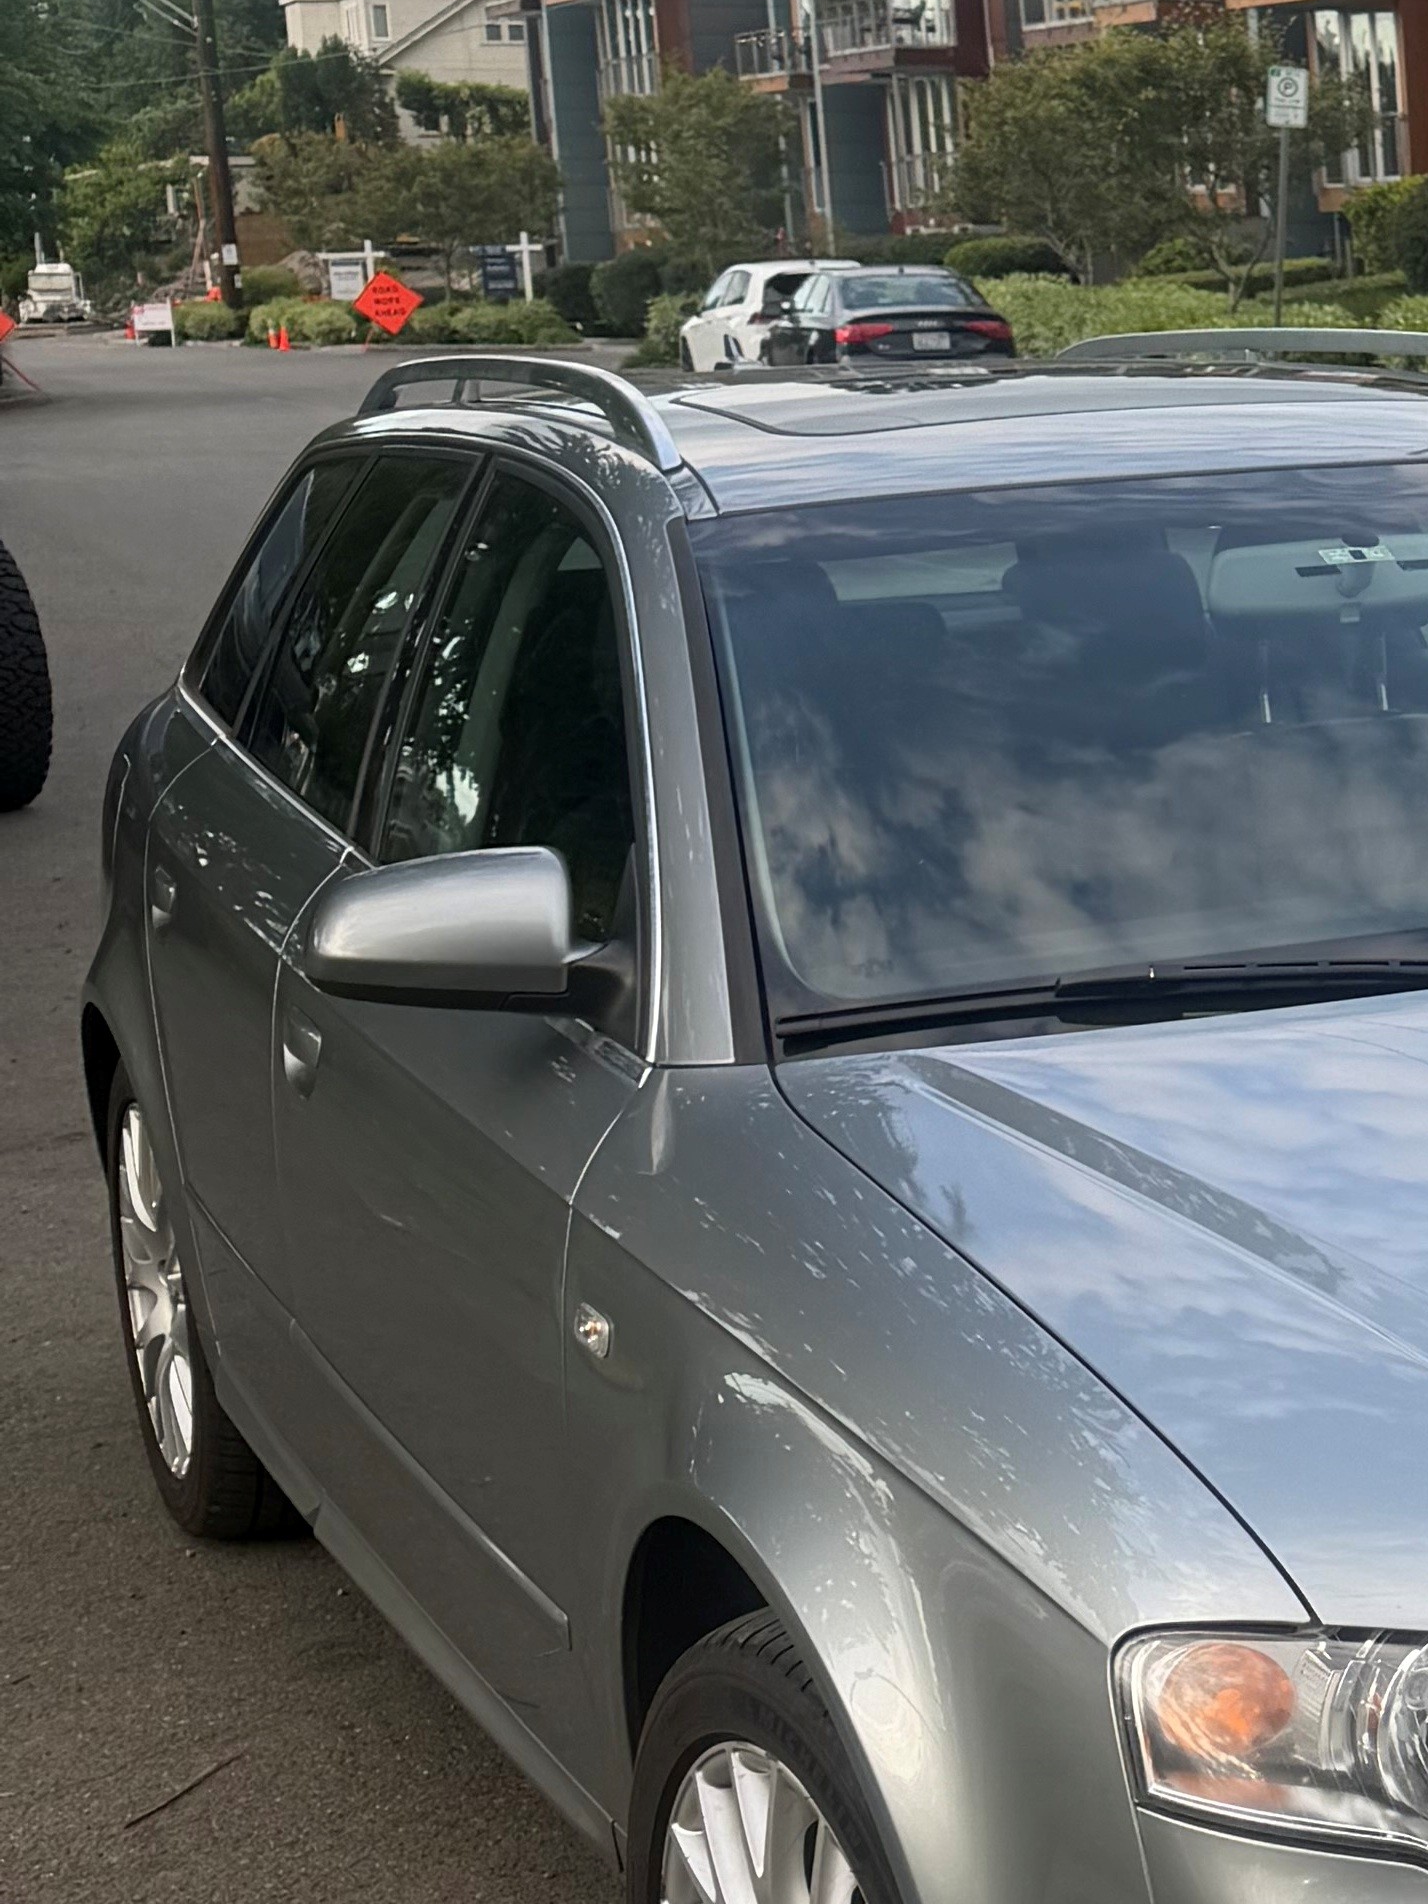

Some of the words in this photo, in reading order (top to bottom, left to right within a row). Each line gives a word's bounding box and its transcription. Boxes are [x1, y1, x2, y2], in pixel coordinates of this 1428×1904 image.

[372, 285, 398, 293] ROAD
[374, 297, 399, 305] WORK
[375, 308, 406, 316] AHEAD
